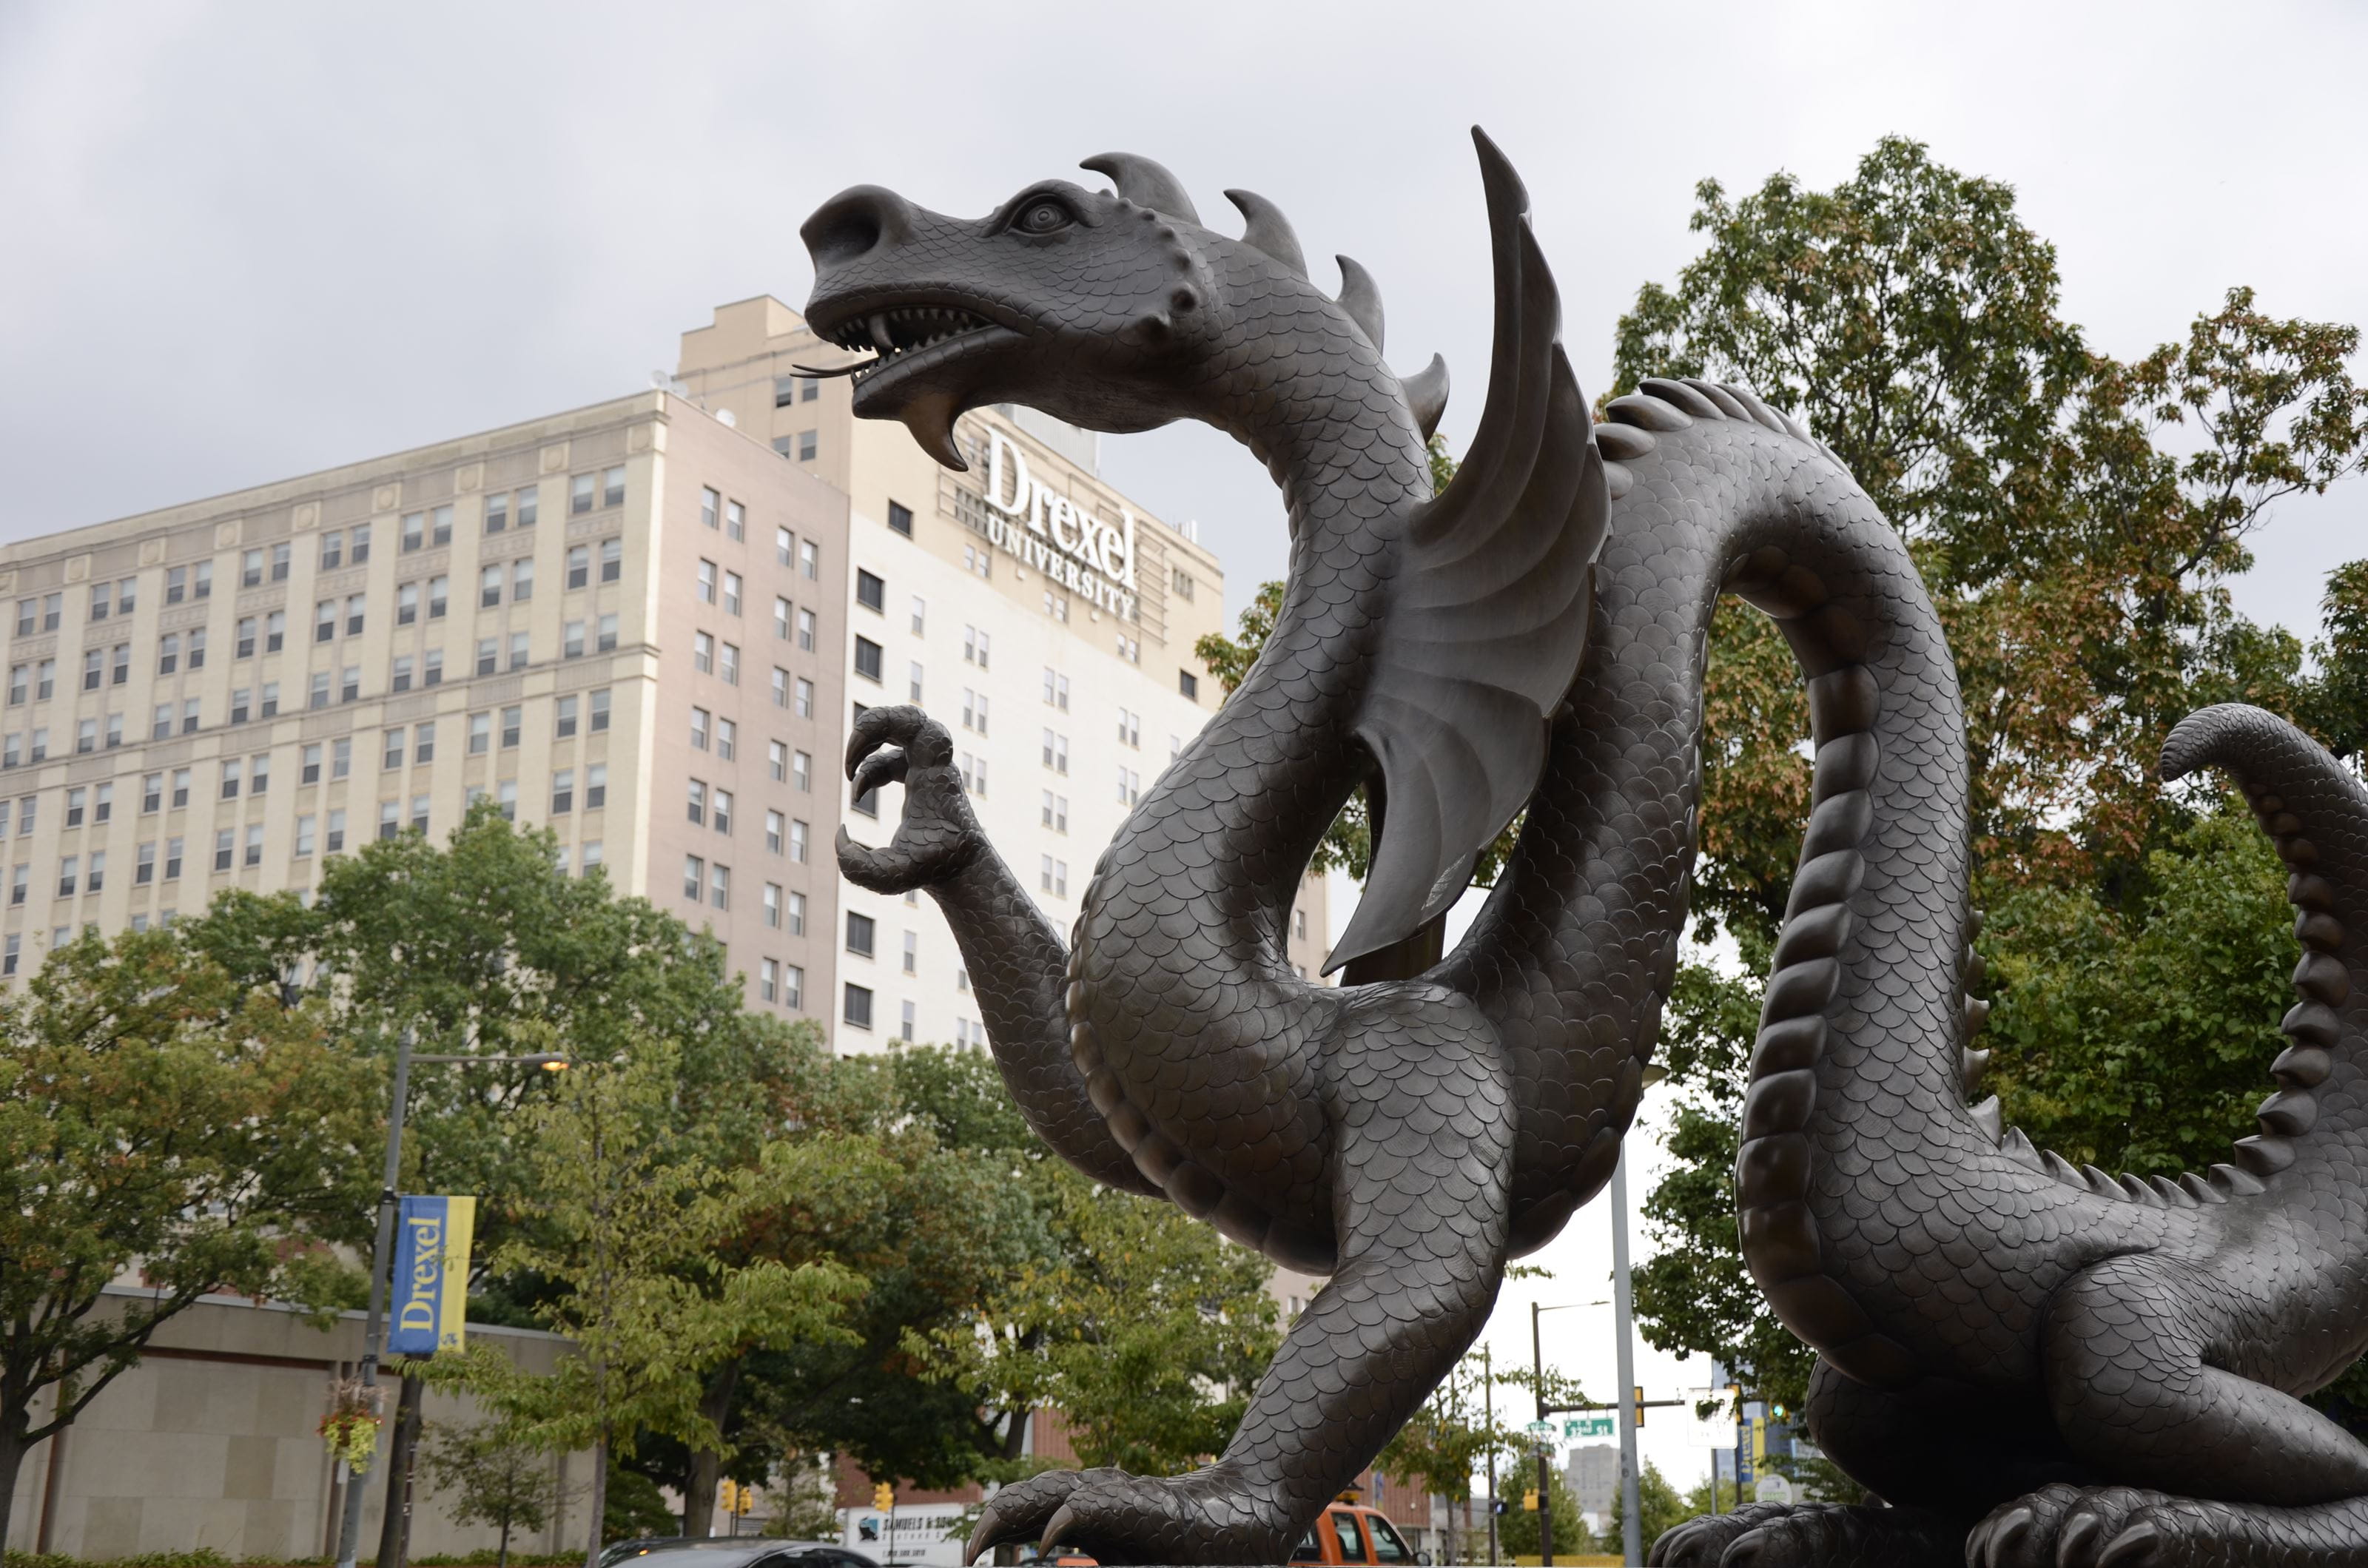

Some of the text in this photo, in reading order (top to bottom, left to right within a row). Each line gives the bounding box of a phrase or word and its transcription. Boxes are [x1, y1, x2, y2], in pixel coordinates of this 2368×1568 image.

[984, 426, 1138, 591] Drexel
[987, 513, 1135, 622] UNIVERSITY
[400, 1217, 441, 1333] Drexel
